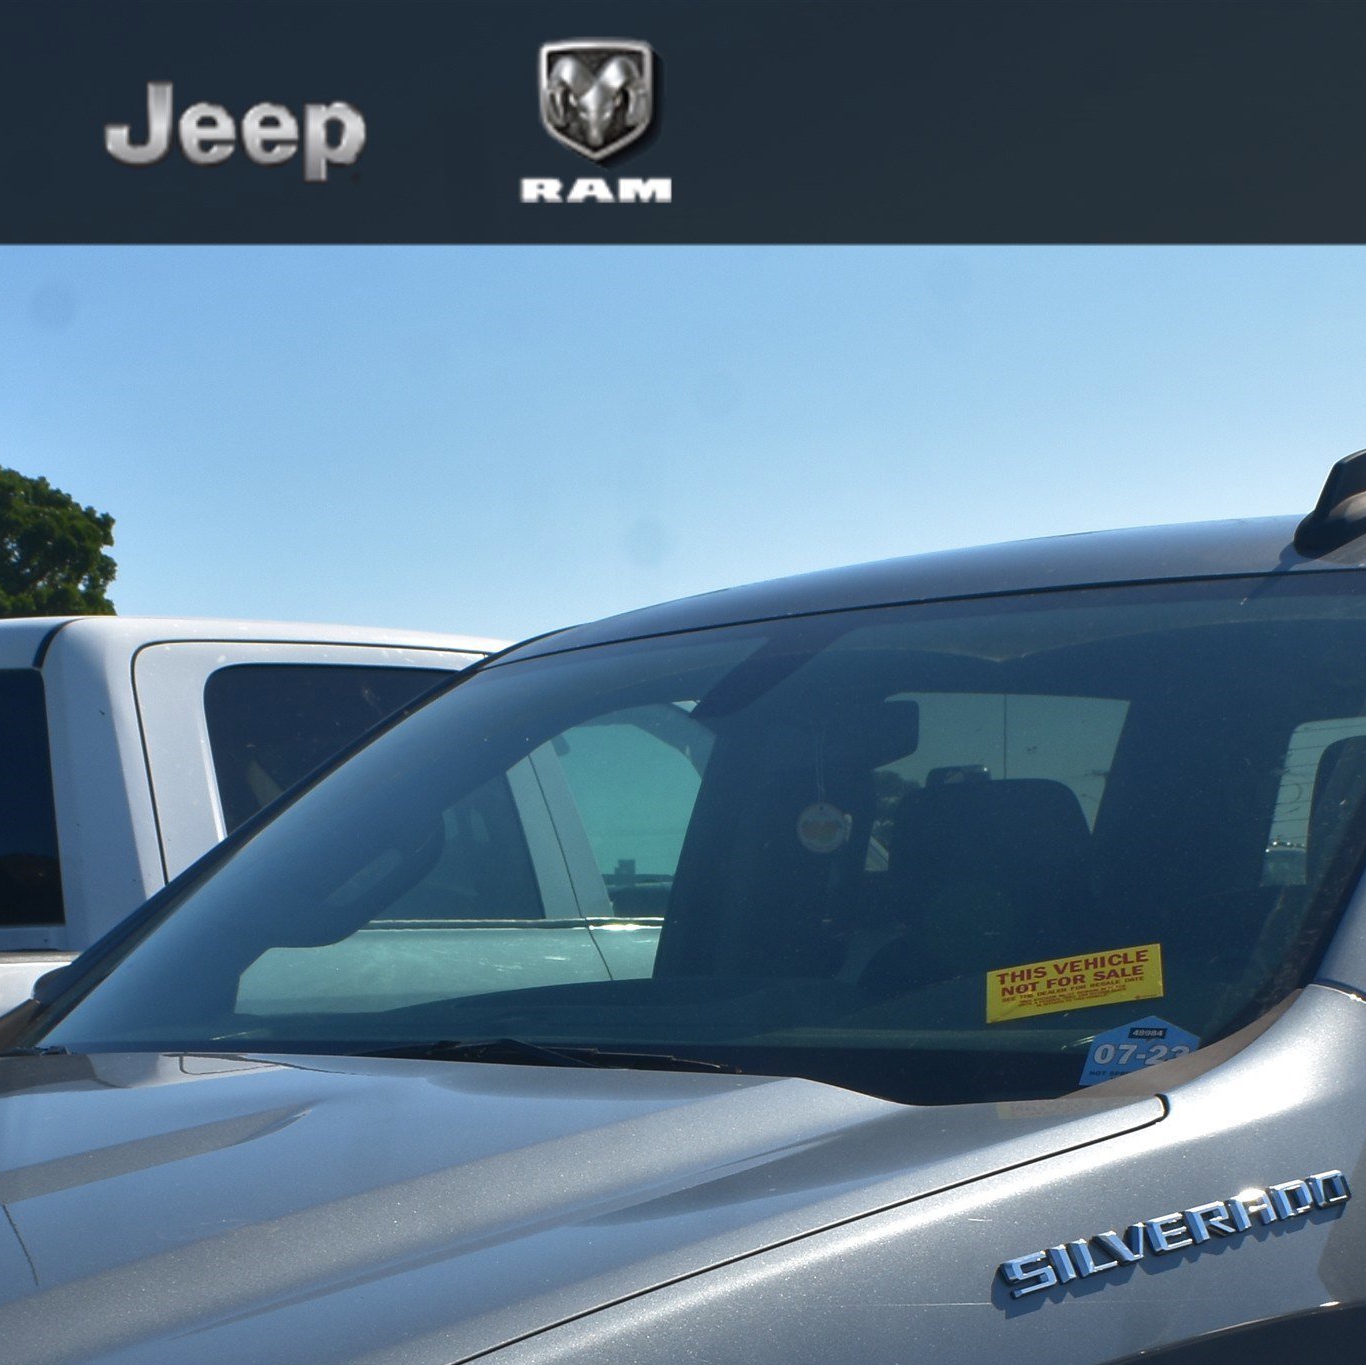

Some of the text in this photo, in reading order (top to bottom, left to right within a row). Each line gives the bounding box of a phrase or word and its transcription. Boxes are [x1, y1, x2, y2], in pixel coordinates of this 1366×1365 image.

[996, 949, 1149, 985] THIS VEHICLE
[1001, 981, 1040, 997] NOT
[1046, 974, 1086, 989] FOR
[1093, 964, 1144, 981] SALE
[1036, 987, 1067, 997] DEALER
[1090, 979, 1121, 988] RESALE
[998, 1169, 1351, 1300] SILVERADO
